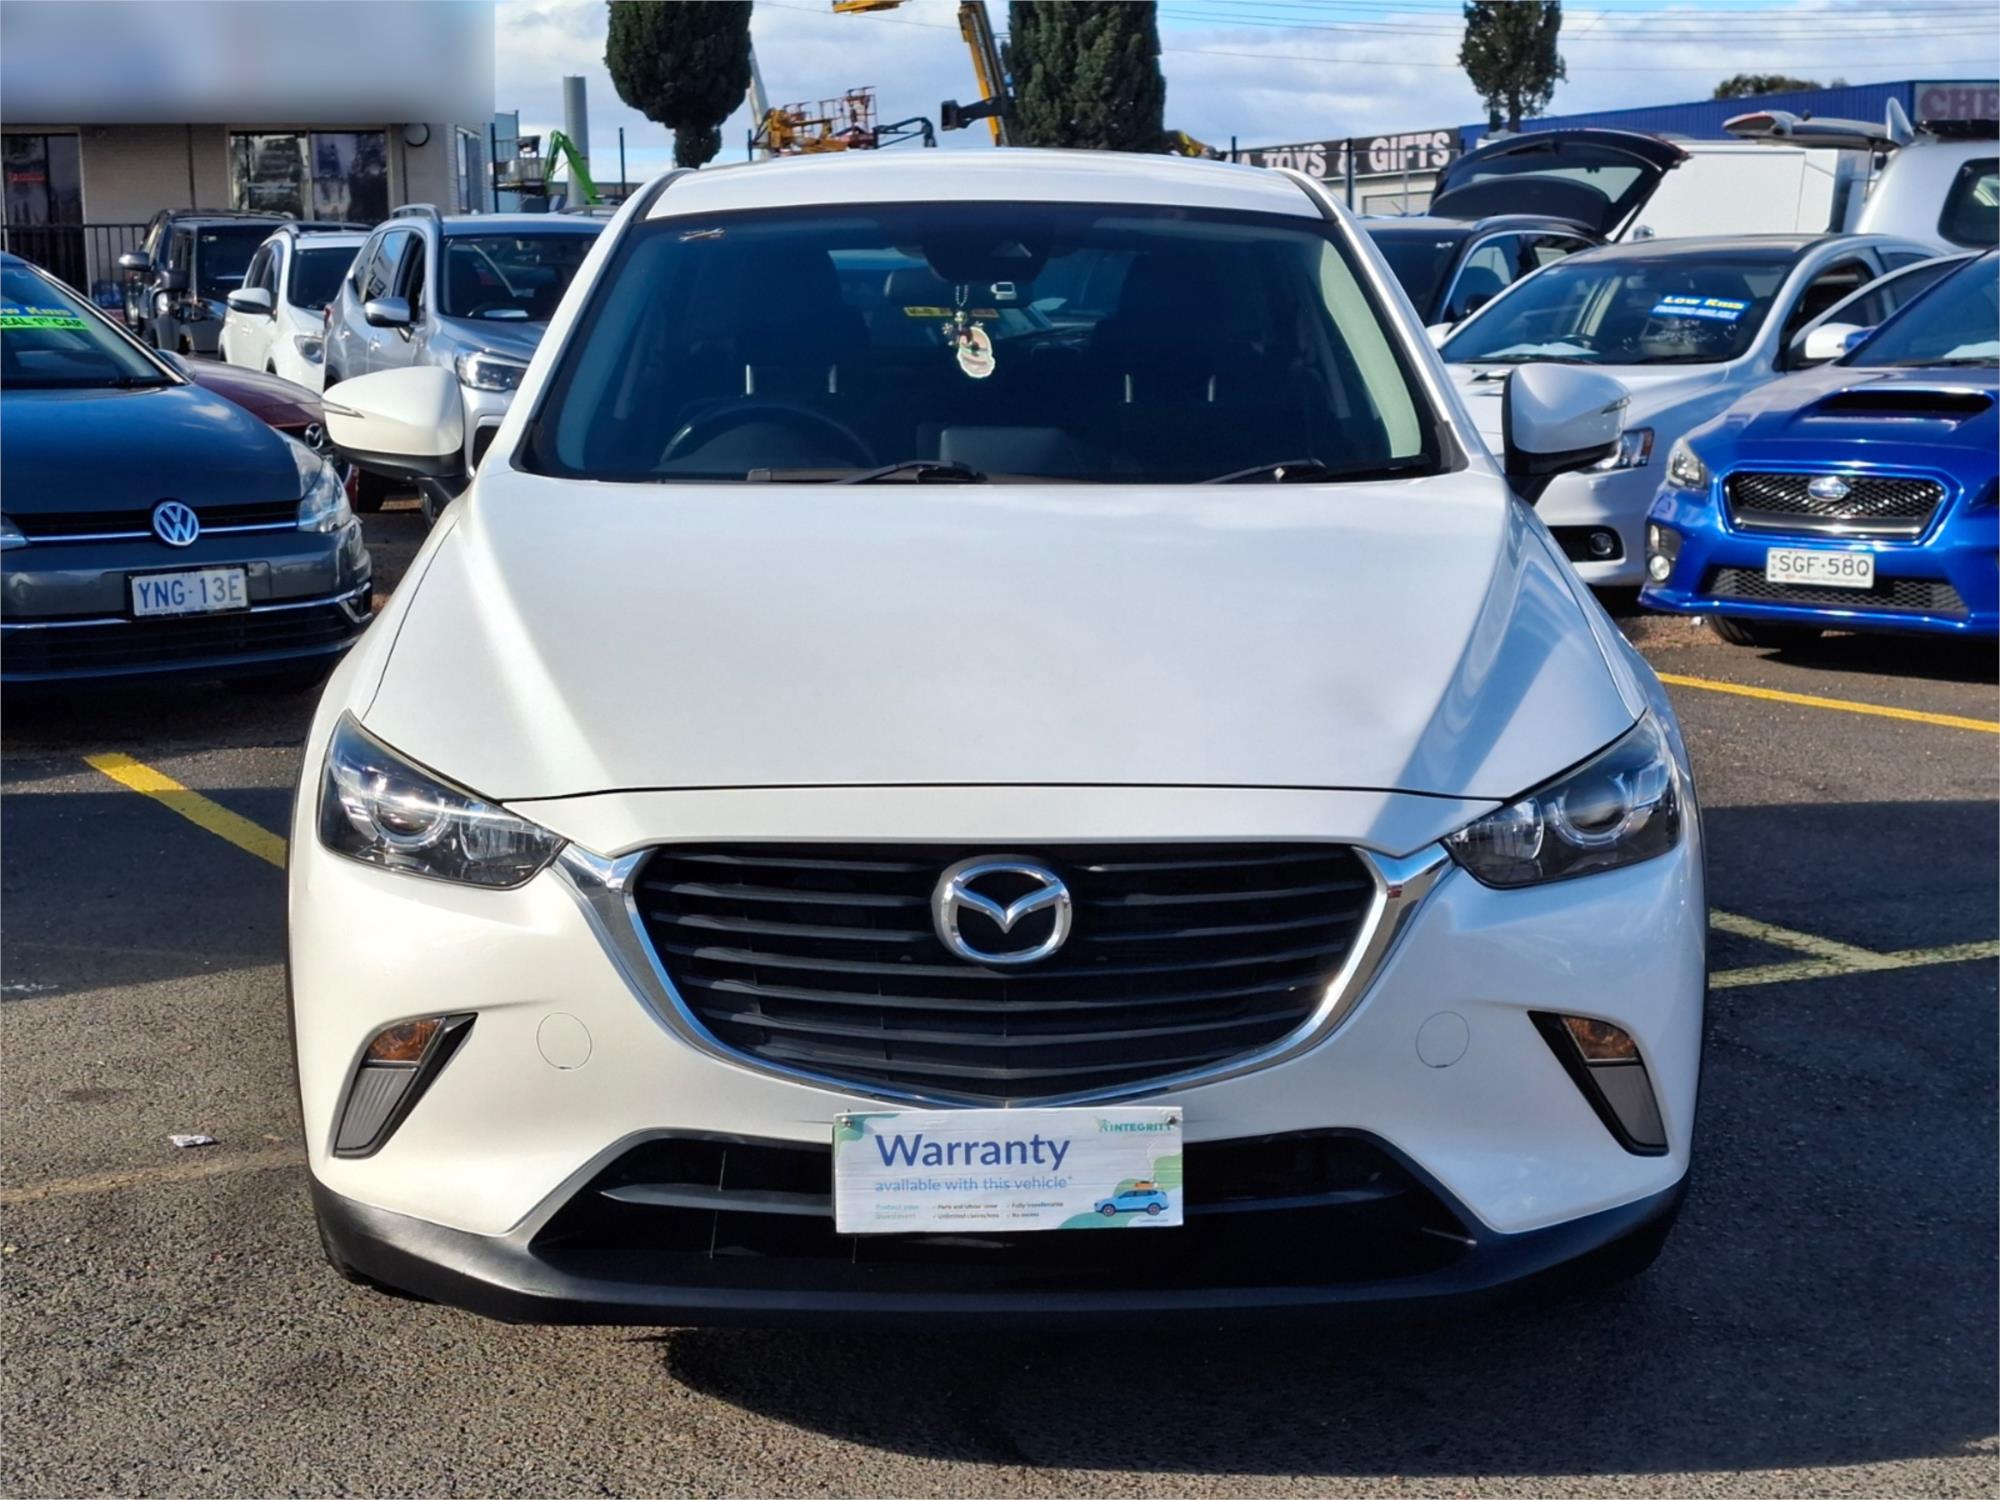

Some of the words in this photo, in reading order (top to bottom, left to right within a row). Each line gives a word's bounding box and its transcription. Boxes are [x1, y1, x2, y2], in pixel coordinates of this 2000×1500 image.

[1262, 144, 1327, 177] TOYS
[1369, 131, 1450, 172] GIFTS
[875, 1134, 1071, 1171] Warranty
[875, 1179, 941, 1192] available
[944, 1178, 978, 1191] with
[983, 1177, 1010, 1190] this
